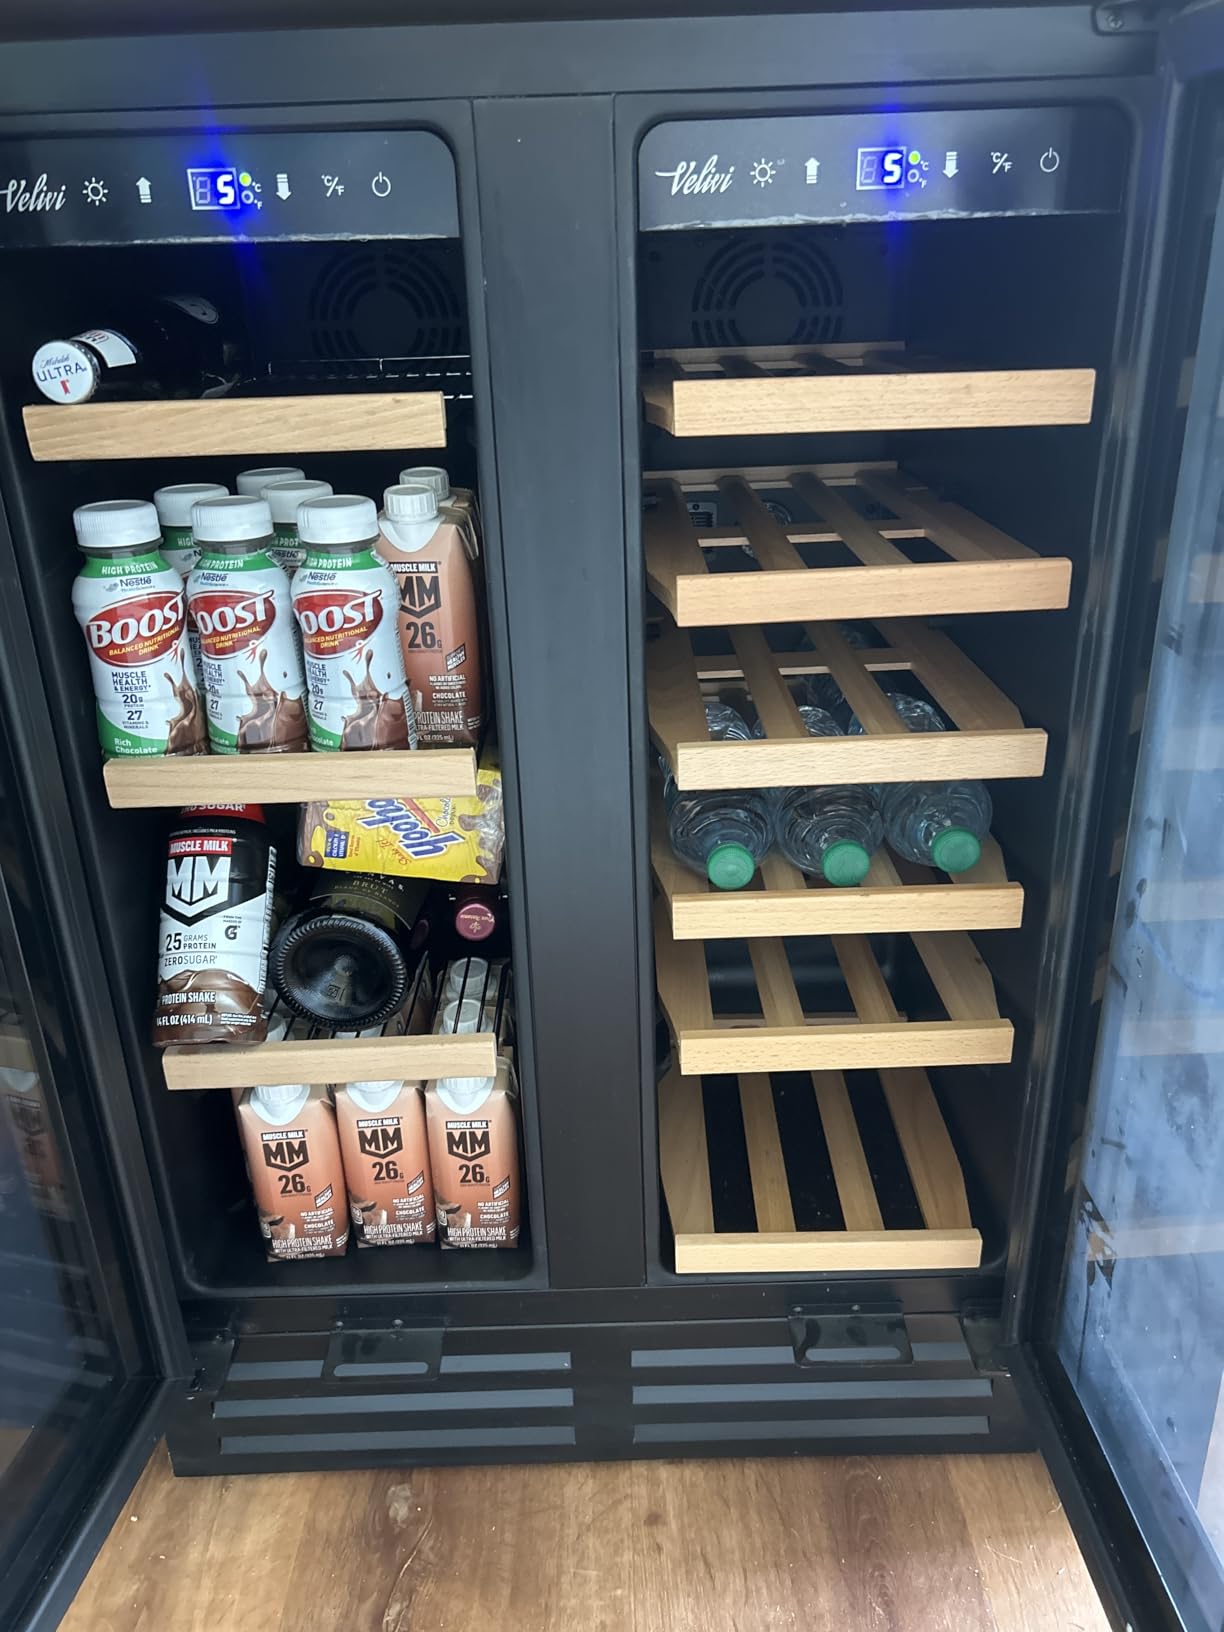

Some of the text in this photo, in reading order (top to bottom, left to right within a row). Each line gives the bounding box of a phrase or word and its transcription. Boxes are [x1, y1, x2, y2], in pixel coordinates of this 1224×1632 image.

[655, 155, 733, 196] Velivi
[0, 174, 66, 212] Velivi
[36, 362, 87, 382] ULTRA
[101, 561, 158, 576] HIGH PROTEIN
[210, 560, 244, 570] PROTEIN
[318, 557, 352, 569] PROTEIN
[390, 563, 436, 572] MUSCLE MILK
[119, 575, 152, 587] Nestlé
[200, 572, 229, 582] Nestlé
[308, 572, 337, 581] Nestlé
[86, 589, 185, 649] BOOST
[220, 627, 261, 641] NUTRITIONAL
[325, 626, 369, 641] NUTRITIONAL
[108, 626, 180, 656] BALANCED NUTRITIONAL
[215, 640, 235, 649] DRINK
[320, 640, 340, 649] DRINK
[138, 644, 160, 656] DRINK
[111, 671, 147, 679] MUSCLE
[437, 674, 466, 682] ARTIFICIAL
[432, 691, 467, 699] CHOCOLATE
[210, 700, 219, 710] 27
[313, 700, 324, 710] 27
[126, 710, 143, 721] 27
[441, 711, 464, 724] SHAKE
[114, 738, 132, 746] Rich
[115, 746, 158, 754] Chocolate
[170, 839, 229, 854] MUSCLE MILK
[166, 856, 232, 918] MM
[352, 880, 389, 894] BRUT
[165, 932, 182, 952] 25
[183, 934, 208, 942] GRAMS
[183, 942, 217, 950] PROTEIN
[162, 991, 217, 1005] PROTEIN SHAKE
[170, 1015, 180, 1025] OZ
[180, 1014, 196, 1026] (414
[197, 1014, 213, 1025] mL)
[357, 1119, 383, 1127] MUSCLE
[447, 1121, 471, 1129] MUSCLE
[262, 1131, 304, 1140] MUSCLE MILK
[358, 1127, 403, 1159] MM
[446, 1131, 491, 1161] MM
[262, 1140, 310, 1172] MM
[395, 1206, 425, 1216] CHOCOLATE
[303, 1219, 334, 1229] CHOCOLATE
[363, 1224, 378, 1234] HIGH
[378, 1223, 402, 1233] PROTEIN
[402, 1222, 423, 1232] SHAKE
[447, 1228, 462, 1237] HIGH
[462, 1227, 486, 1236] PROTEIN
[487, 1226, 507, 1235] SHAKE
[271, 1238, 287, 1249] HIGH
[287, 1236, 313, 1248] PROTEIN
[313, 1233, 332, 1245] SHAKE
